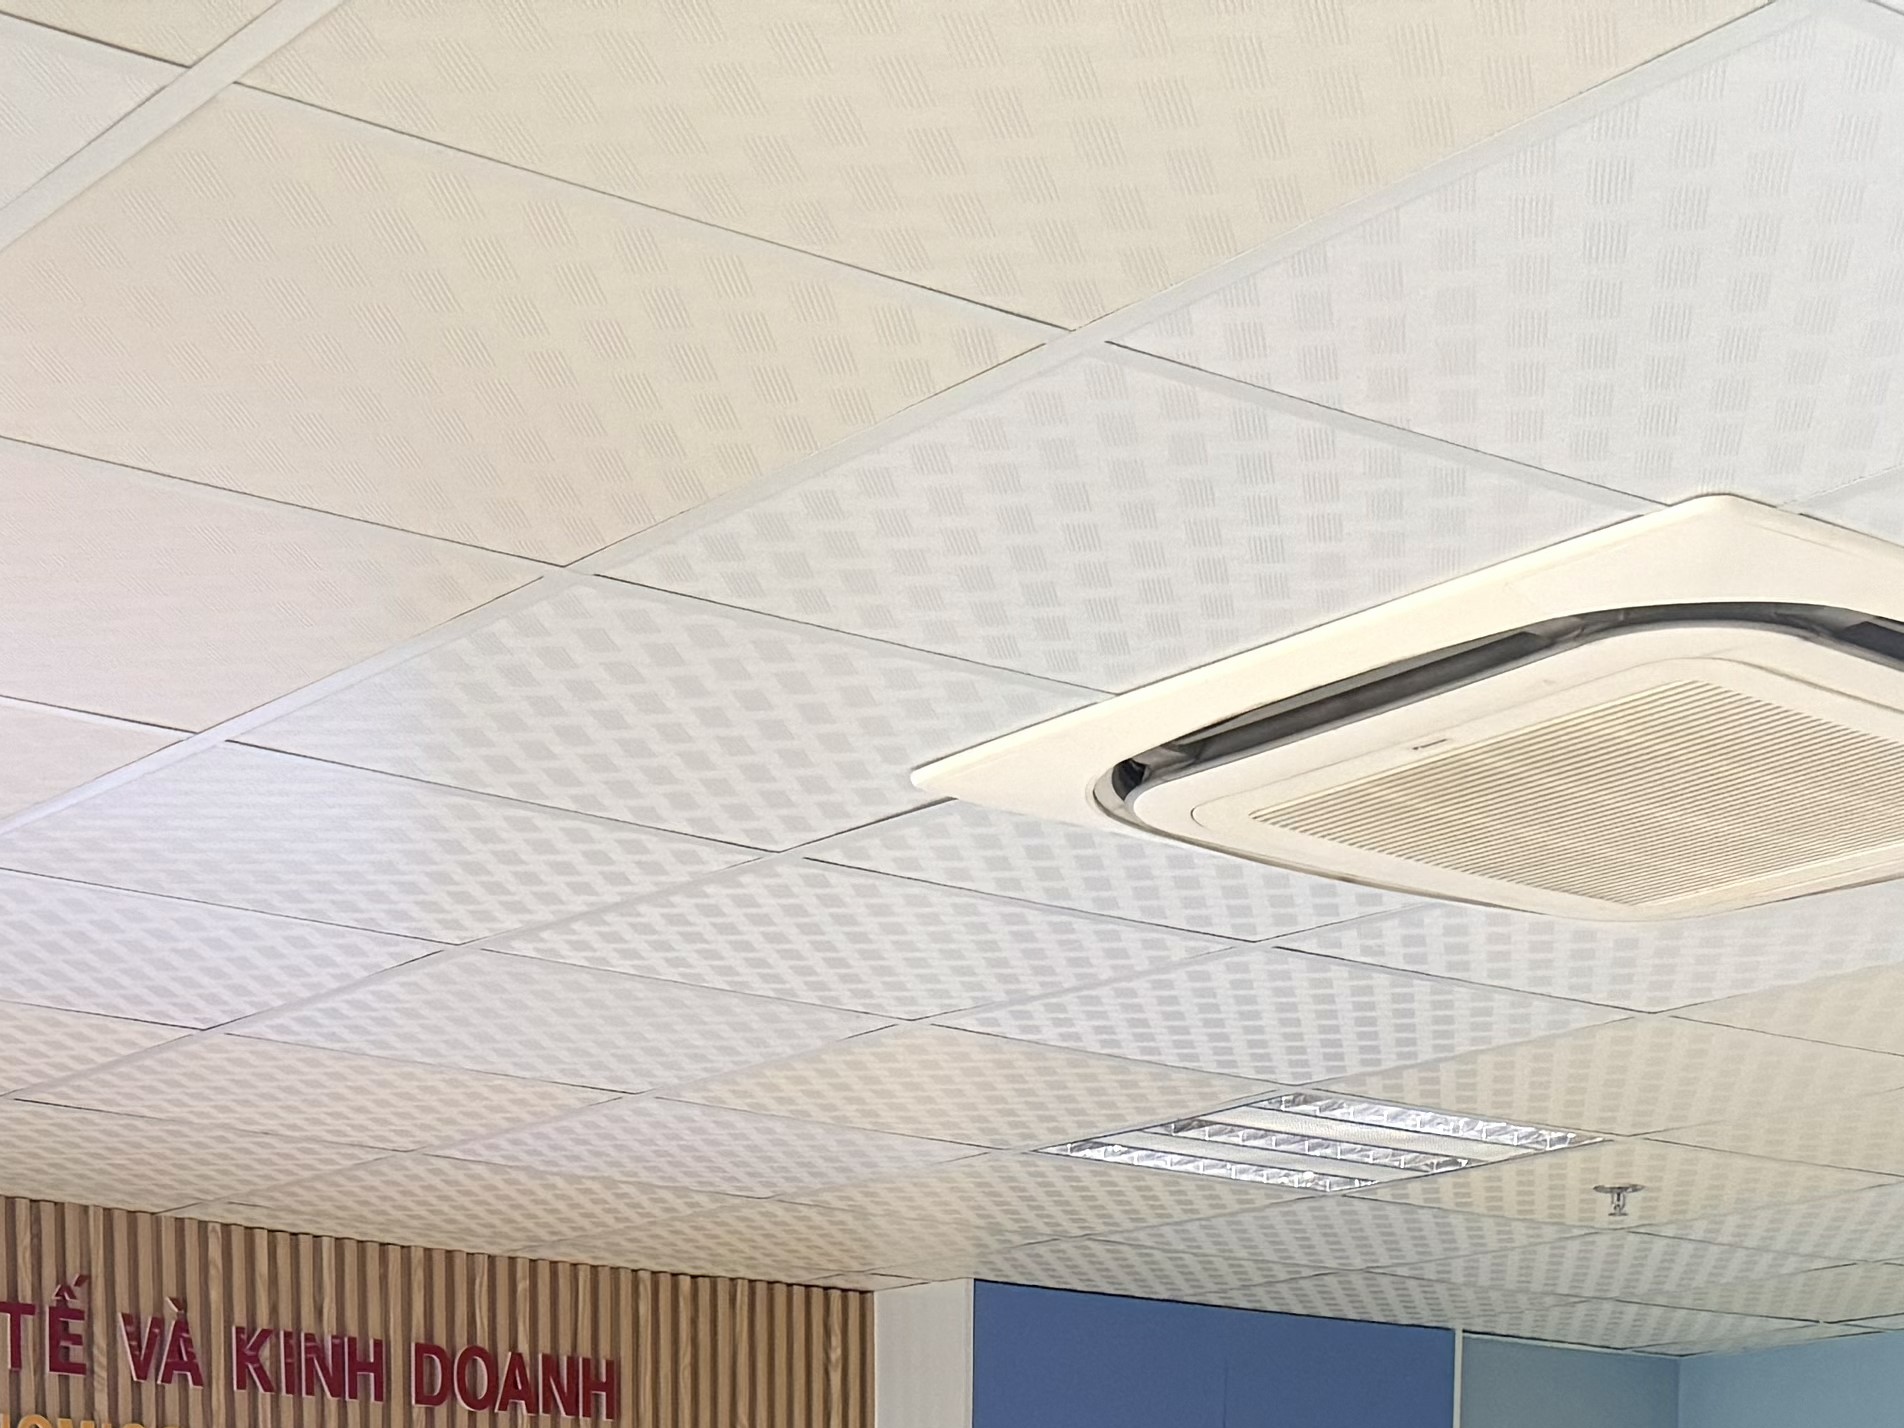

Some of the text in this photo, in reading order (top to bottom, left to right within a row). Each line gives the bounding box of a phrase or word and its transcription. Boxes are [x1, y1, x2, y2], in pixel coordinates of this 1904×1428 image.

[118, 1297, 205, 1388] VÀ
[232, 1324, 386, 1403] KINH
[411, 1341, 620, 1420] DOANH
